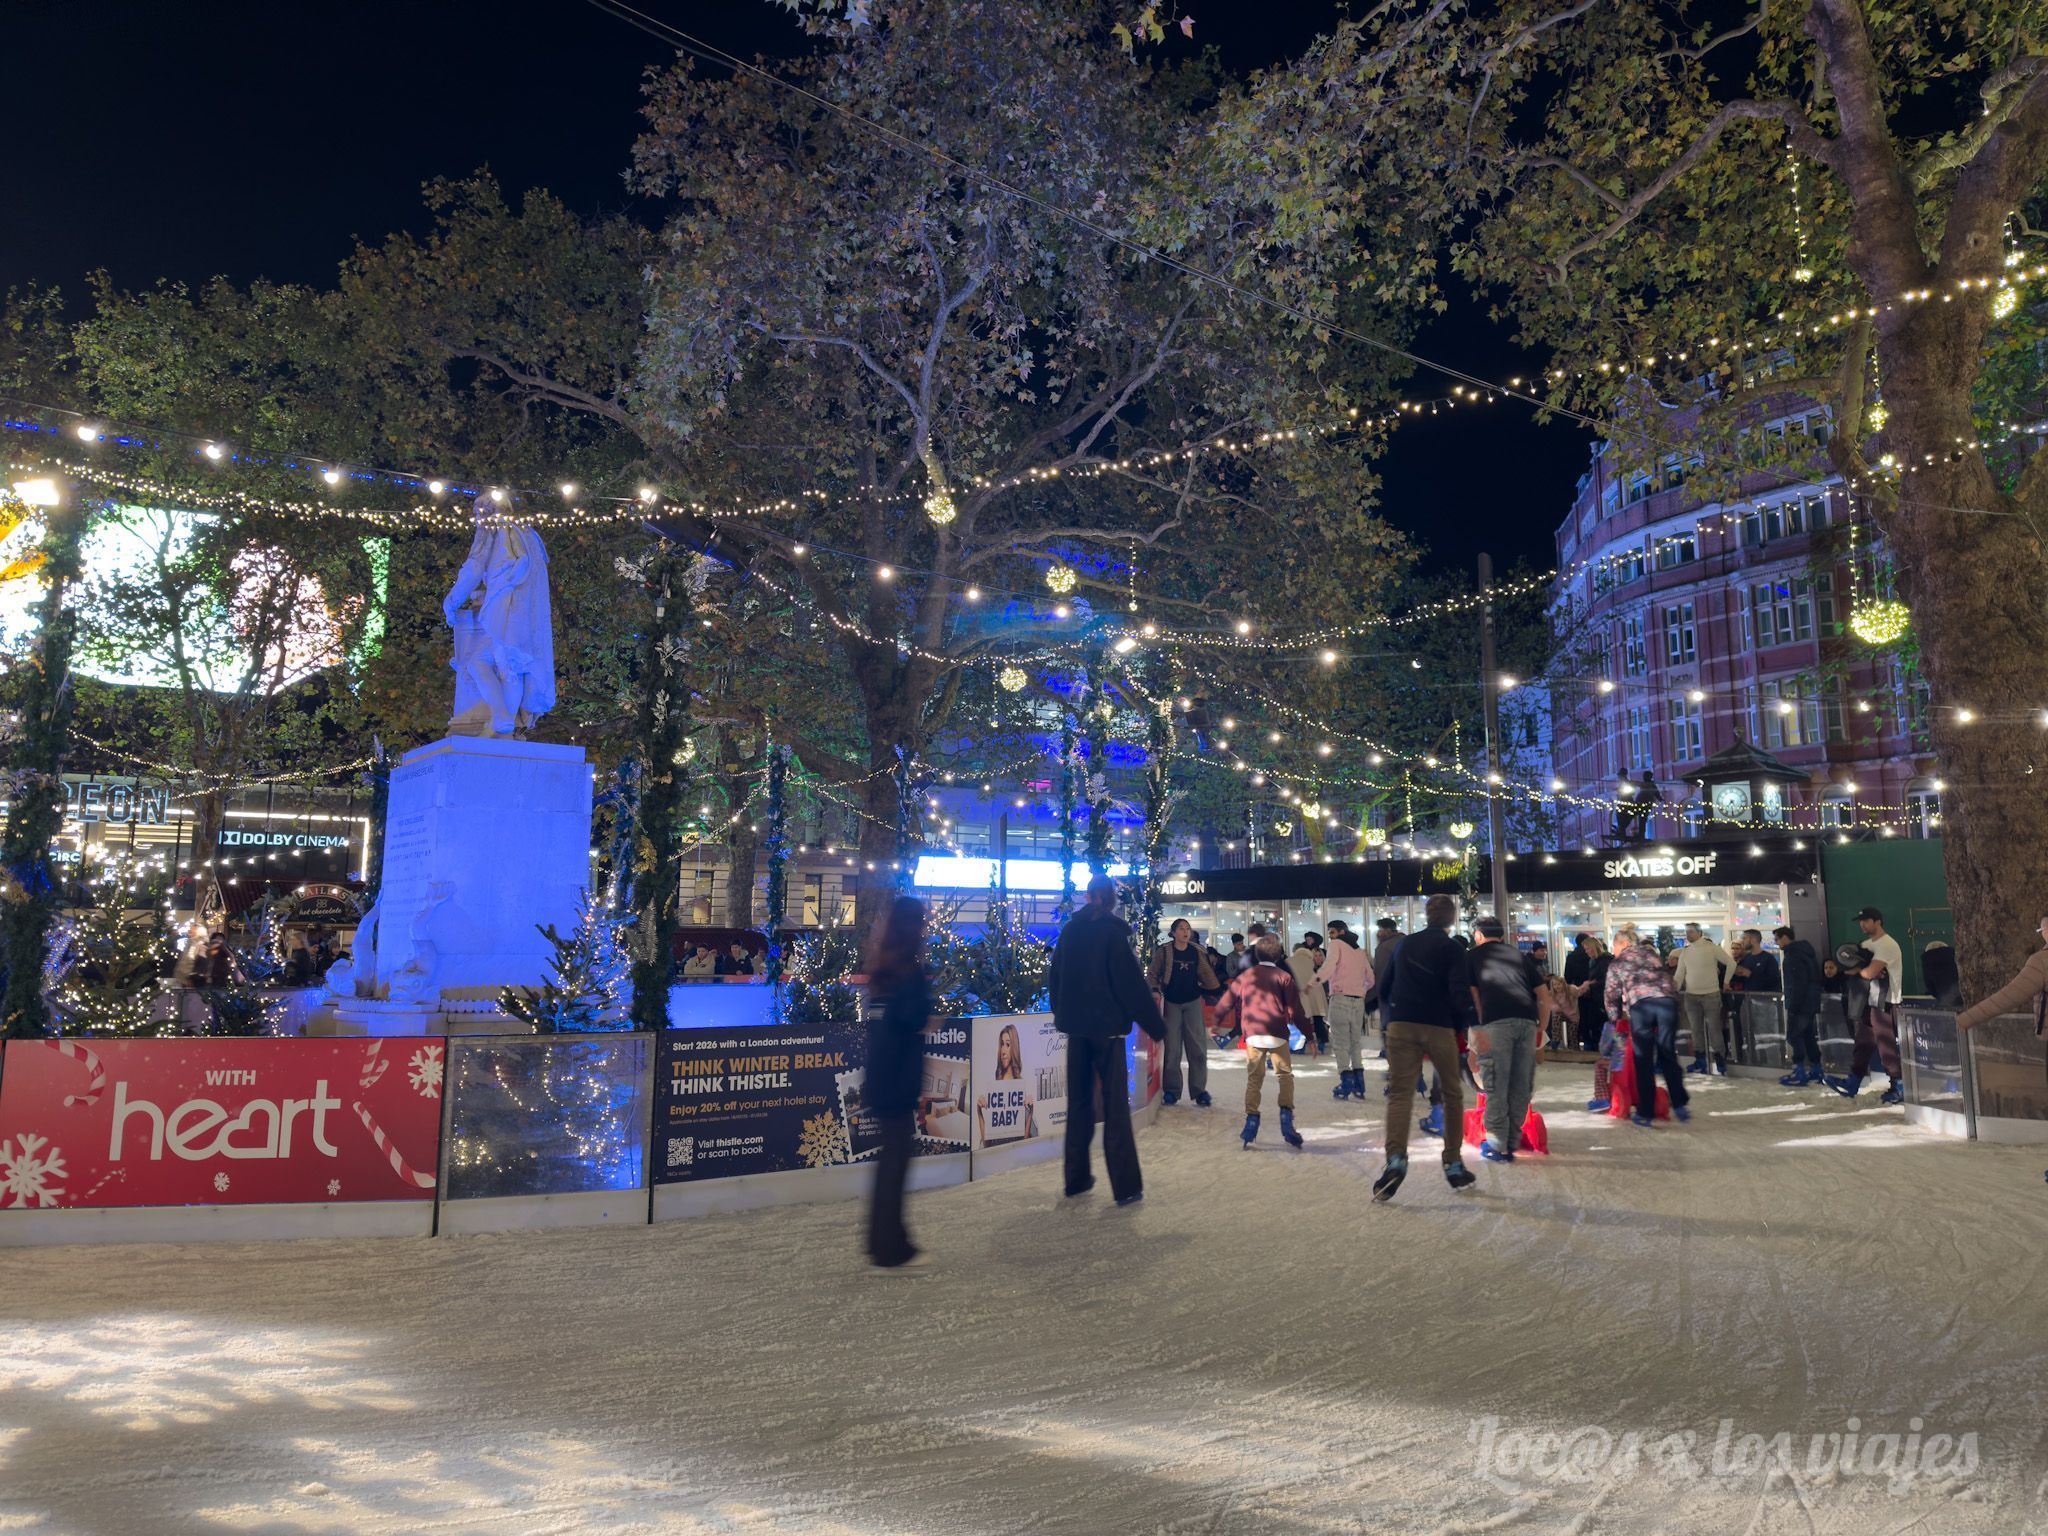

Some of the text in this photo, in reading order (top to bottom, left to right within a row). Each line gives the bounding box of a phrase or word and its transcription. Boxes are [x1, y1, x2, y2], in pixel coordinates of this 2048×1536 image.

[61, 780, 170, 825] EON
[242, 833, 346, 848] DOLBY CINEMA
[1604, 855, 1717, 879] SKATES OFF
[1156, 880, 1205, 895] ATES ON
[672, 1041, 694, 1052] Start
[696, 1040, 718, 1050] 2026
[719, 1039, 738, 1049] with
[748, 1037, 779, 1048] London
[780, 1035, 825, 1046] adventure!
[671, 1051, 849, 1077] THINK WINTER BREAK.
[206, 1069, 257, 1087] WITH
[670, 1072, 792, 1096] THINK THISTLE.
[669, 1094, 827, 1117] Enjoy 20% off your next hotel stay
[987, 1090, 1024, 1110] ICE, ICE
[109, 1079, 342, 1161] heart
[991, 1110, 1019, 1128] BABY
[697, 1135, 764, 1149] Visit thistle.com
[697, 1145, 764, 1160] or scan to book
